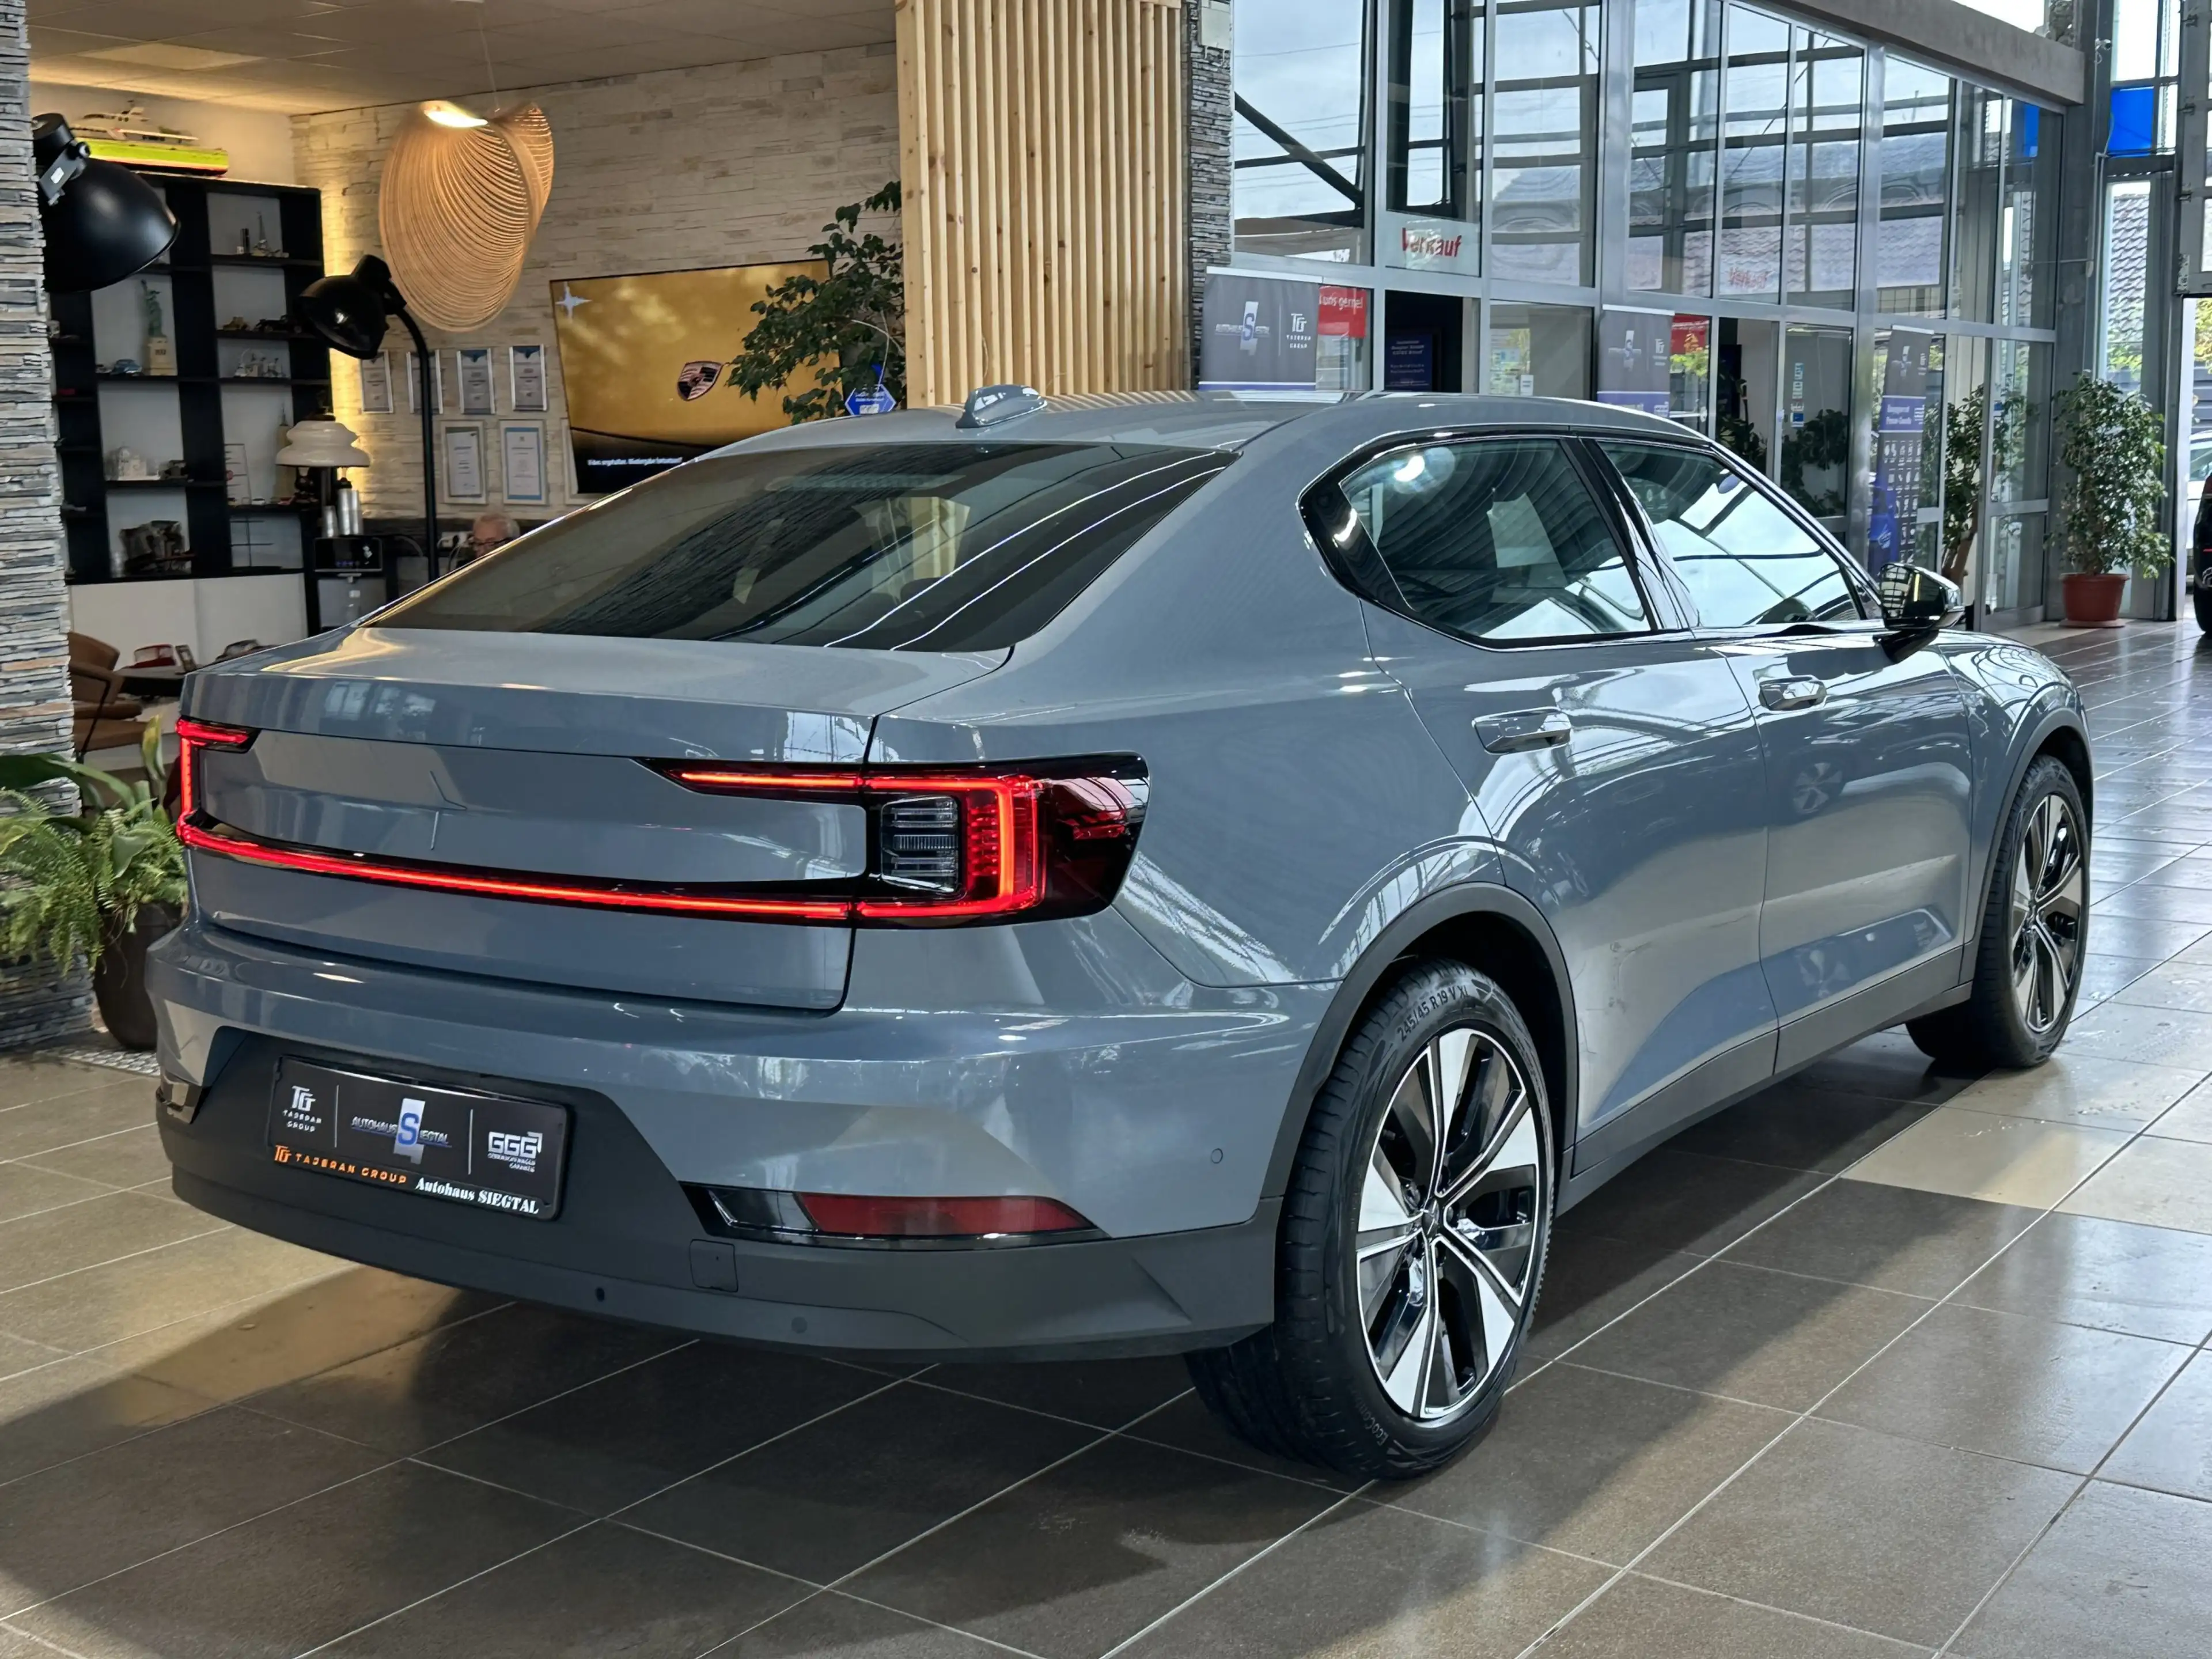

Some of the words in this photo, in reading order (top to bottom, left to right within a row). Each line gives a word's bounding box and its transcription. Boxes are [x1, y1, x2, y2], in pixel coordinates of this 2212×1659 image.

[1396, 1001, 1430, 1042] 245/45
[361, 1167, 407, 1184] GROUP
[415, 1177, 475, 1201] Autohaus
[478, 1189, 539, 1214] SIEGTAL
